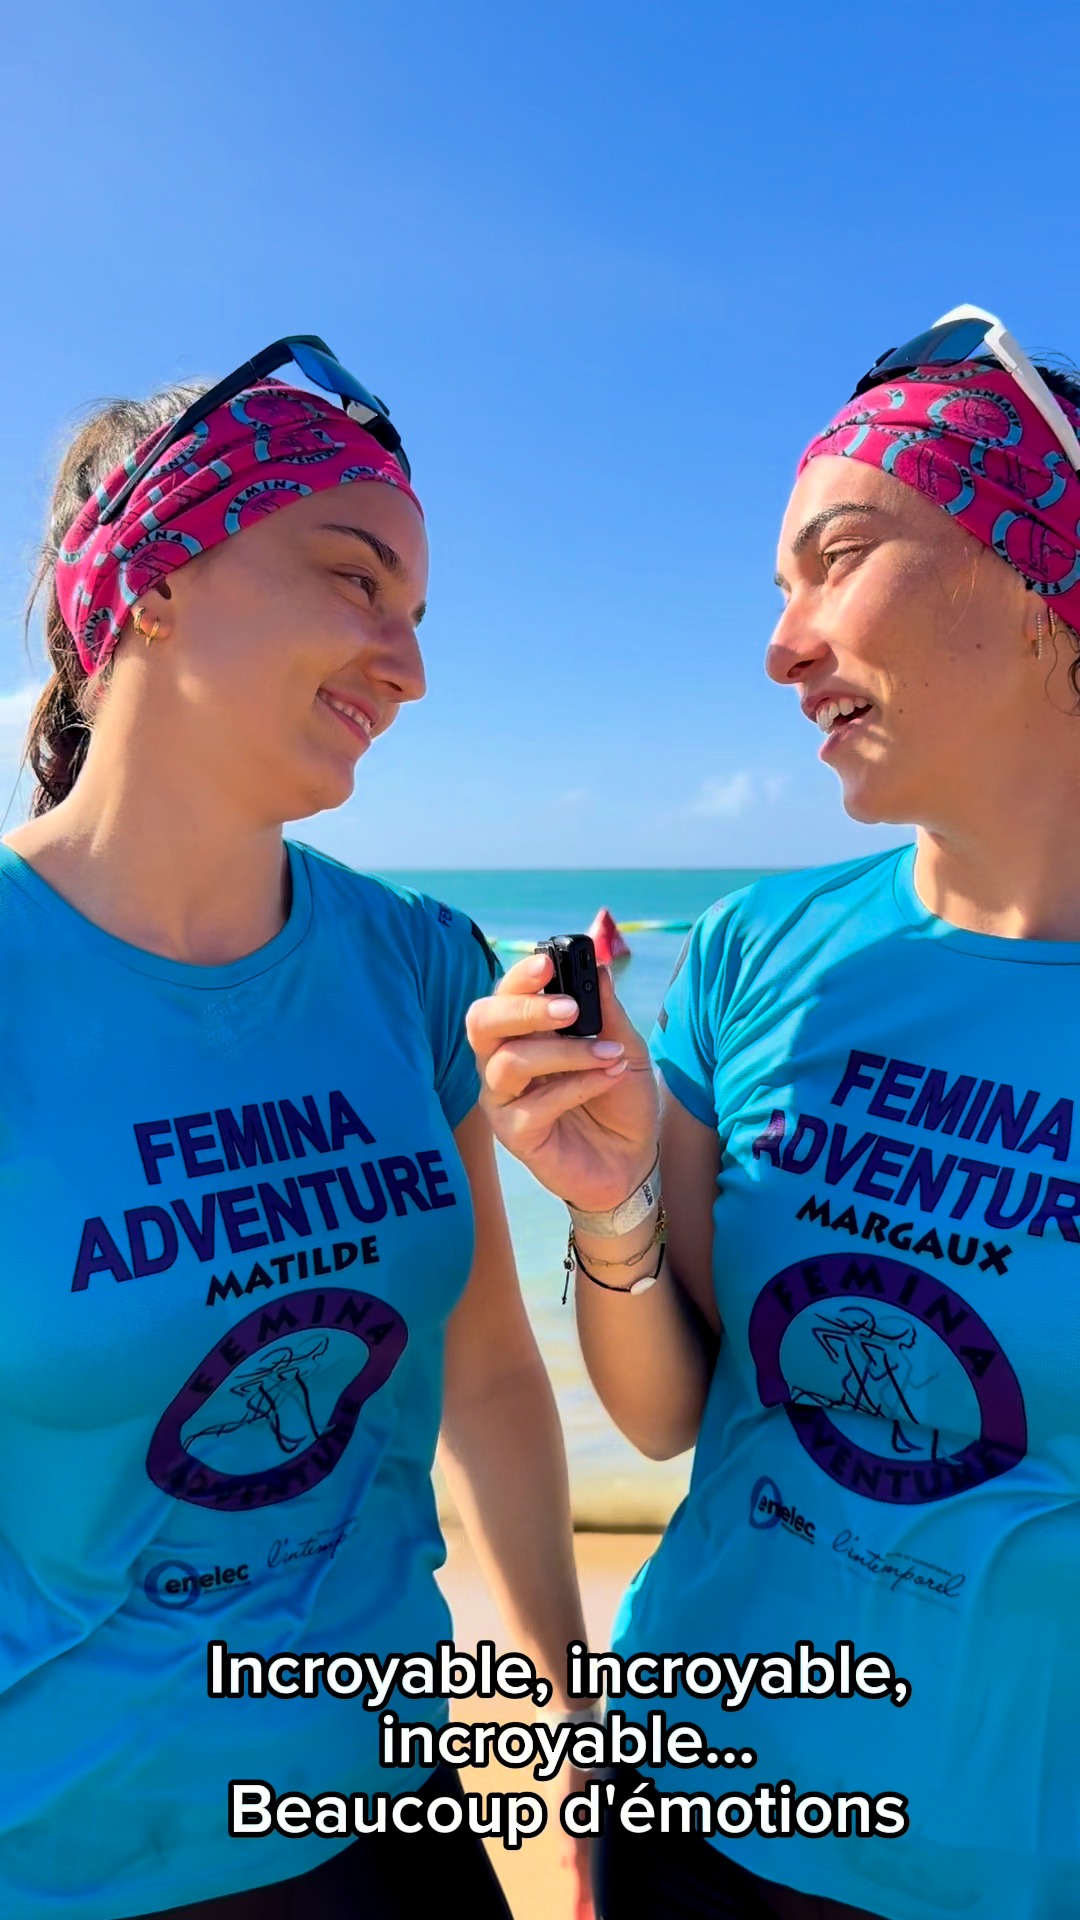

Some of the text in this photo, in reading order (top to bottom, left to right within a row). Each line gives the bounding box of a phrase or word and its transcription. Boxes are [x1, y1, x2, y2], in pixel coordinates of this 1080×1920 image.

[228, 479, 302, 514] FEMINA
[133, 1090, 376, 1185] FEMINA
[830, 1049, 1074, 1162] FEMINA
[752, 1109, 1080, 1243] ADVENTUR
[71, 1150, 456, 1292] ADVENTURE
[795, 1194, 1013, 1276] MARGAUX
[206, 1235, 380, 1306] MATILDE
[189, 1294, 397, 1394] FEMINA
[770, 1259, 998, 1379] FEMINA
[811, 1420, 1004, 1499] VENTURE
[758, 1495, 816, 1539] enelec
[164, 1563, 250, 1595] enelec
